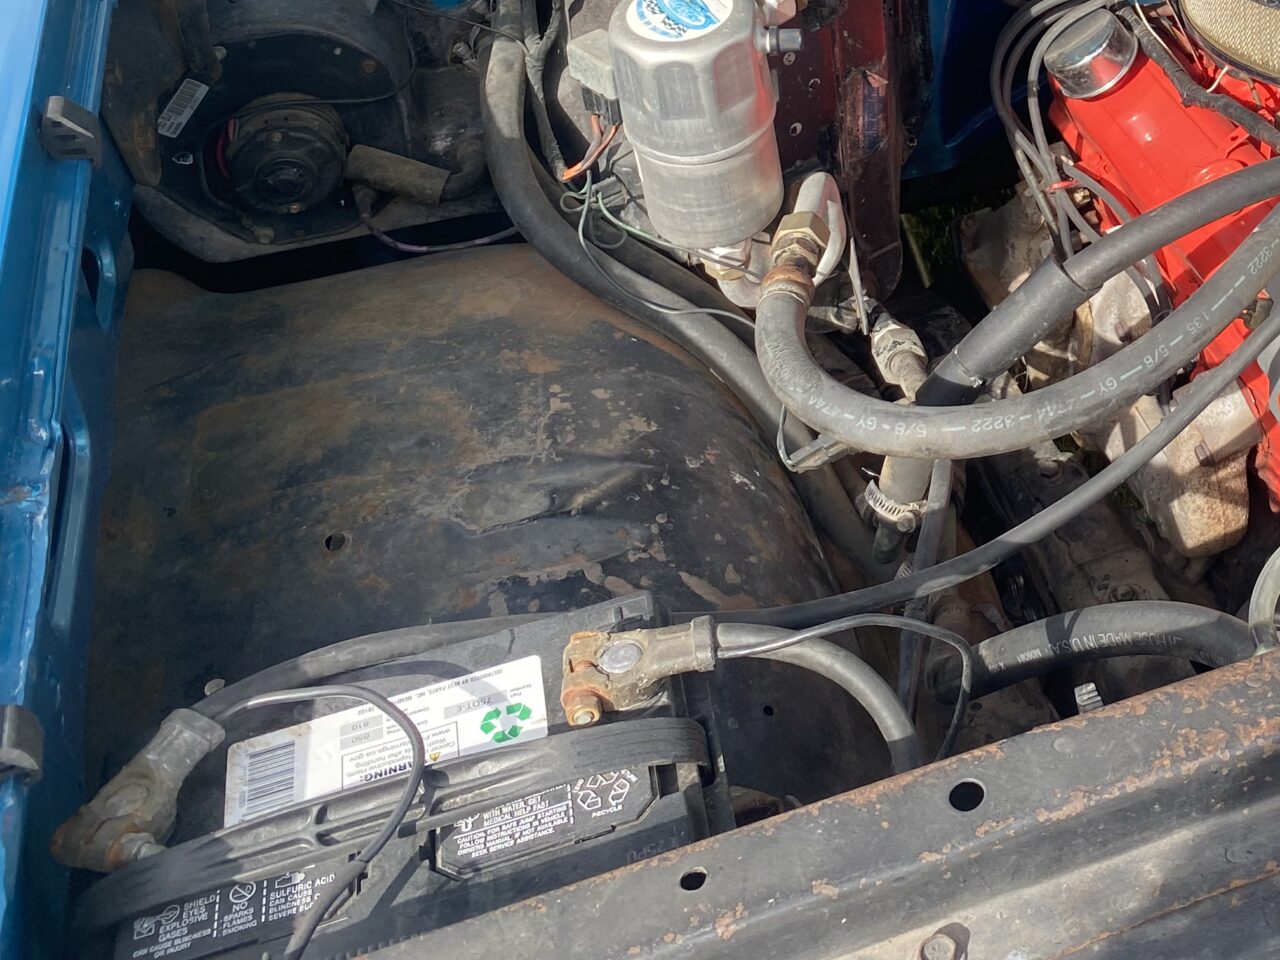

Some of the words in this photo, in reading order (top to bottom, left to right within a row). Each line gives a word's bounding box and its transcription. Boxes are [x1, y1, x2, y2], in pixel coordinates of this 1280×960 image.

[1144, 344, 1170, 366] 5/8
[1100, 377, 1117, 393] GY
[855, 415, 877, 429] GY
[895, 422, 927, 437] 5/8
[971, 413, 1016, 432] 3222
[1084, 634, 1099, 650] IN
[1100, 632, 1133, 647] MADE
[483, 808, 500, 818] WITH
[528, 796, 541, 805] GET
[483, 813, 512, 826] MEDICAL
[514, 807, 532, 818] HELP
[533, 801, 549, 811] FAST
[592, 805, 622, 818] RECYCLE
[487, 826, 500, 835] FOR
[501, 820, 518, 830] SAFE
[519, 815, 535, 825] JUMP
[537, 805, 567, 819] STARTING
[457, 844, 485, 855] OWNERS
[522, 827, 535, 836] NOT
[536, 817, 568, 831] AVAILABLE
[460, 837, 485, 849] FOLLOW
[487, 823, 532, 841] INSTRUCTIONS
[540, 811, 565, 823] VEHICLE
[472, 848, 488, 857] SEEK
[489, 840, 514, 852] SERVICE
[270, 881, 312, 899] SULFURIC
[314, 874, 336, 887] ACID
[183, 895, 215, 911] SHIELD
[232, 901, 248, 912] NO
[269, 897, 285, 907] CAN
[287, 890, 313, 902] CAUSE
[269, 897, 311, 914] BLINDNESS
[183, 906, 205, 919] EYES
[268, 908, 297, 922] SEVERE
[159, 913, 208, 934] EXPLOSIVE
[222, 921, 257, 936] SMOKING
[133, 948, 148, 958] CAN
[149, 941, 172, 953] CAUSE
[173, 928, 211, 947] BLINDNESS
[158, 928, 188, 942] GASES
[154, 950, 165, 959] OR
[166, 942, 191, 956] INJURY
